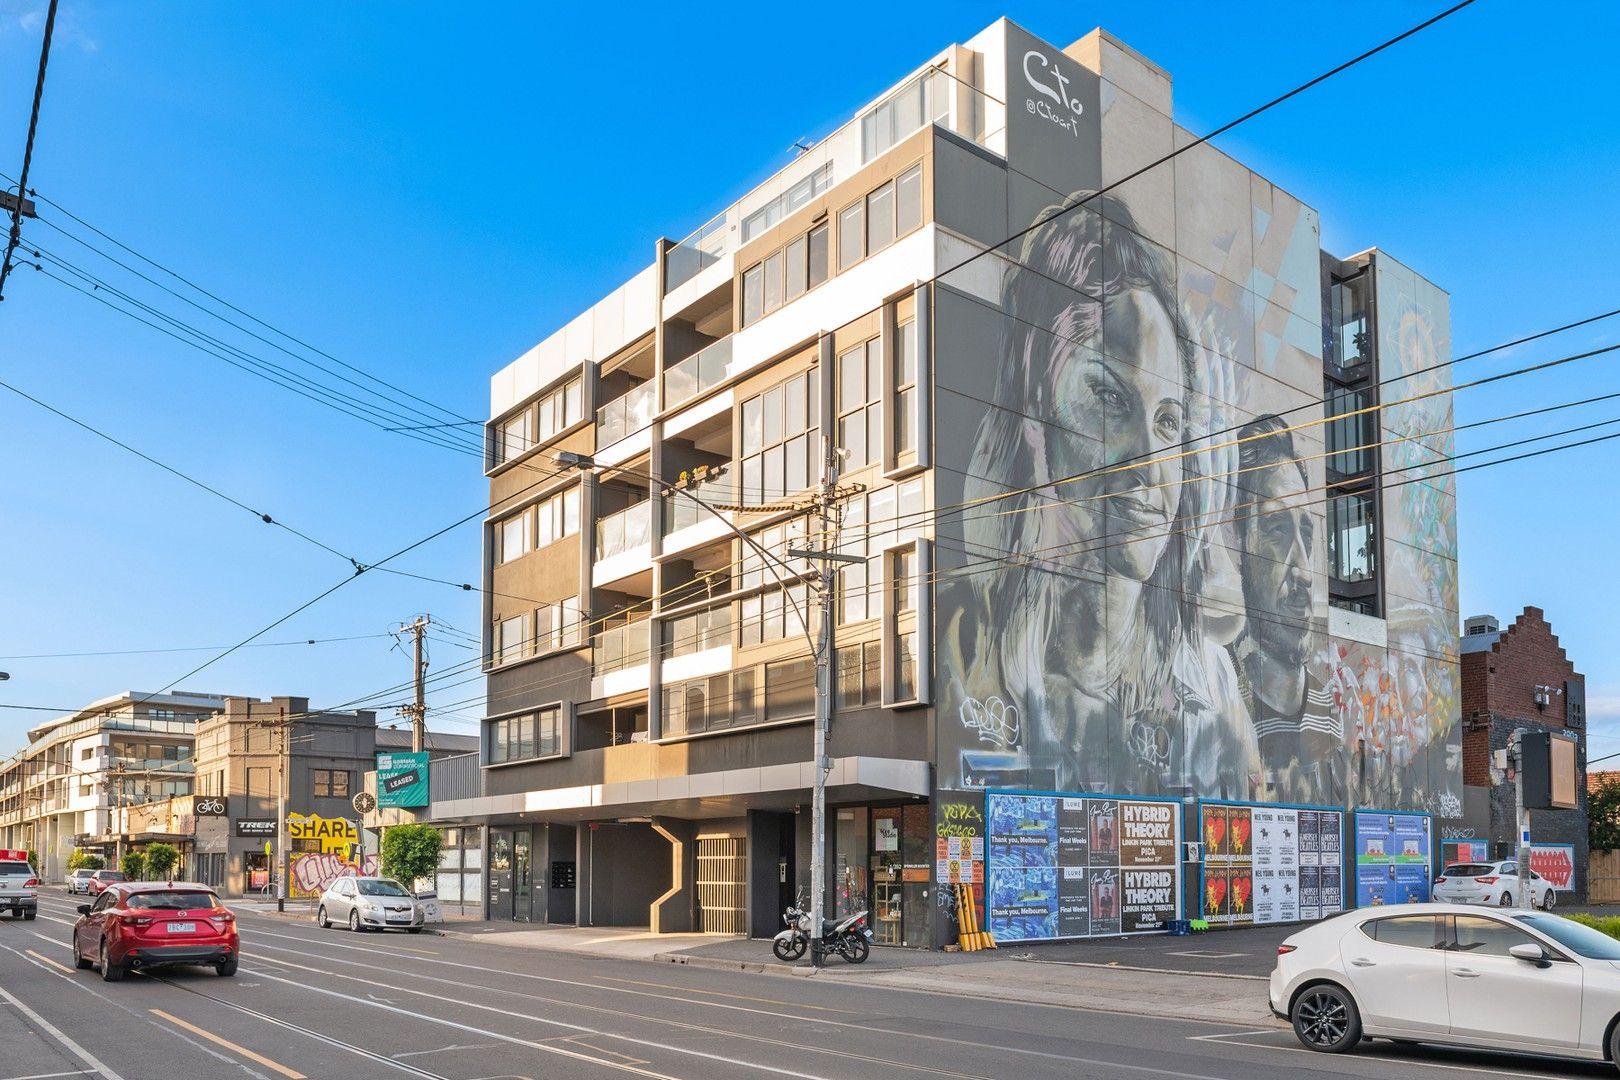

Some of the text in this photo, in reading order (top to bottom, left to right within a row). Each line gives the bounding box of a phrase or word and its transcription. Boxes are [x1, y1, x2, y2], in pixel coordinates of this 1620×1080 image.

[390, 775, 414, 789] LEASED
[1124, 805, 1171, 822] HYBRID
[238, 821, 276, 829] TREK
[290, 821, 357, 838] SHARE
[1125, 822, 1171, 838] THEORY
[1141, 847, 1156, 856] PICA
[1125, 871, 1172, 888] HYBRID
[1125, 888, 1172, 904] THEORY
[1141, 913, 1156, 921] PICA
